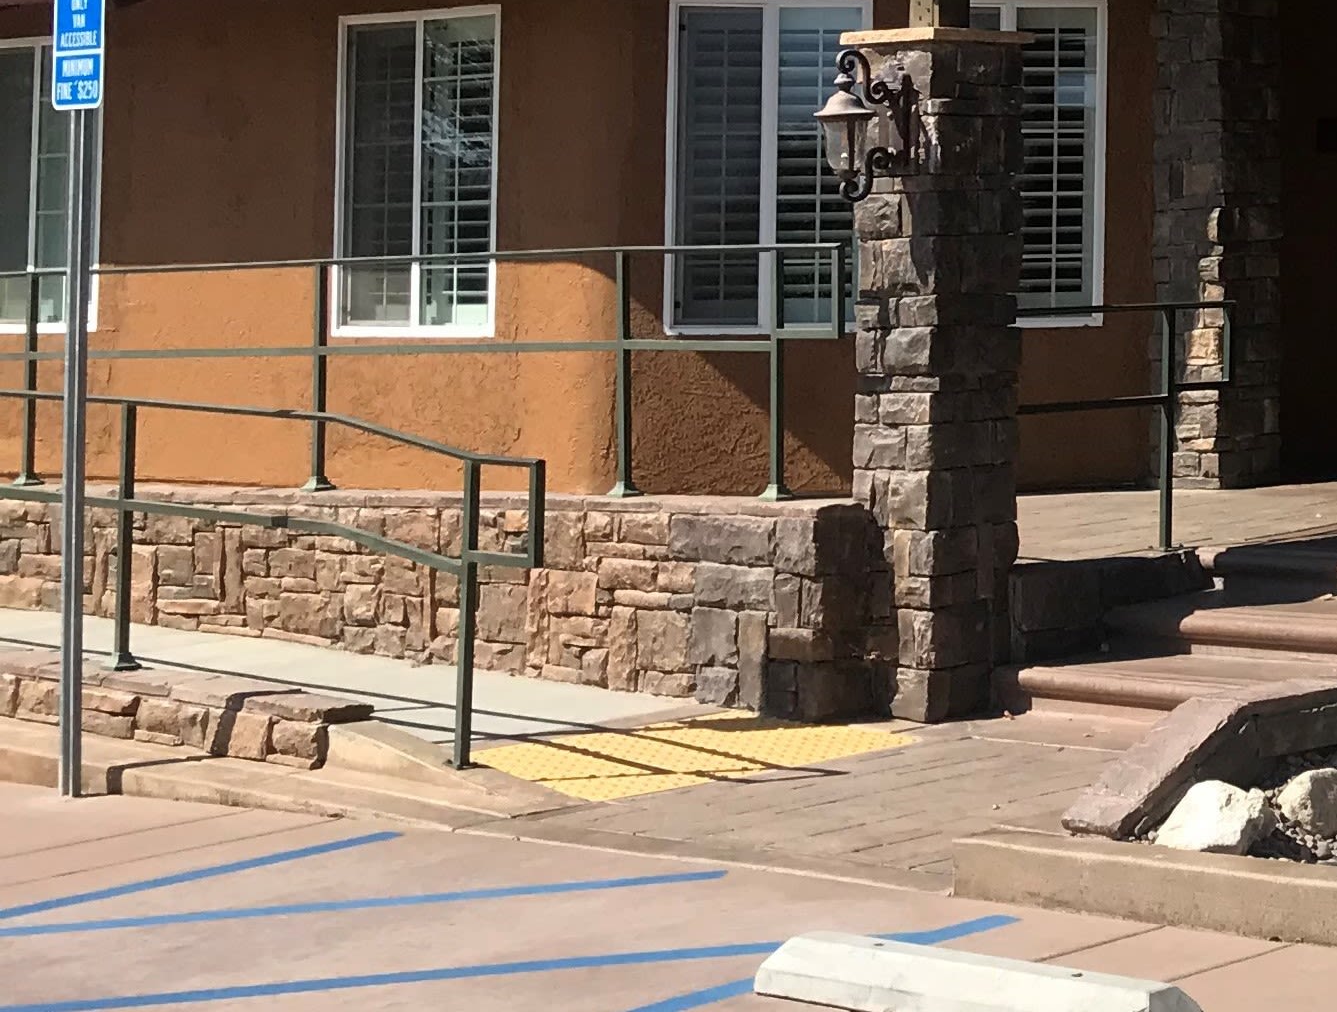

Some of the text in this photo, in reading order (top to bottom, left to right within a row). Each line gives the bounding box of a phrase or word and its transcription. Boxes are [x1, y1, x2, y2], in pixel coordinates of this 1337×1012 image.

[72, 13, 85, 28] VAN
[60, 30, 97, 47] ACCESSIBLE
[62, 58, 94, 77] MINIMUM
[56, 79, 98, 100] FINE $250
